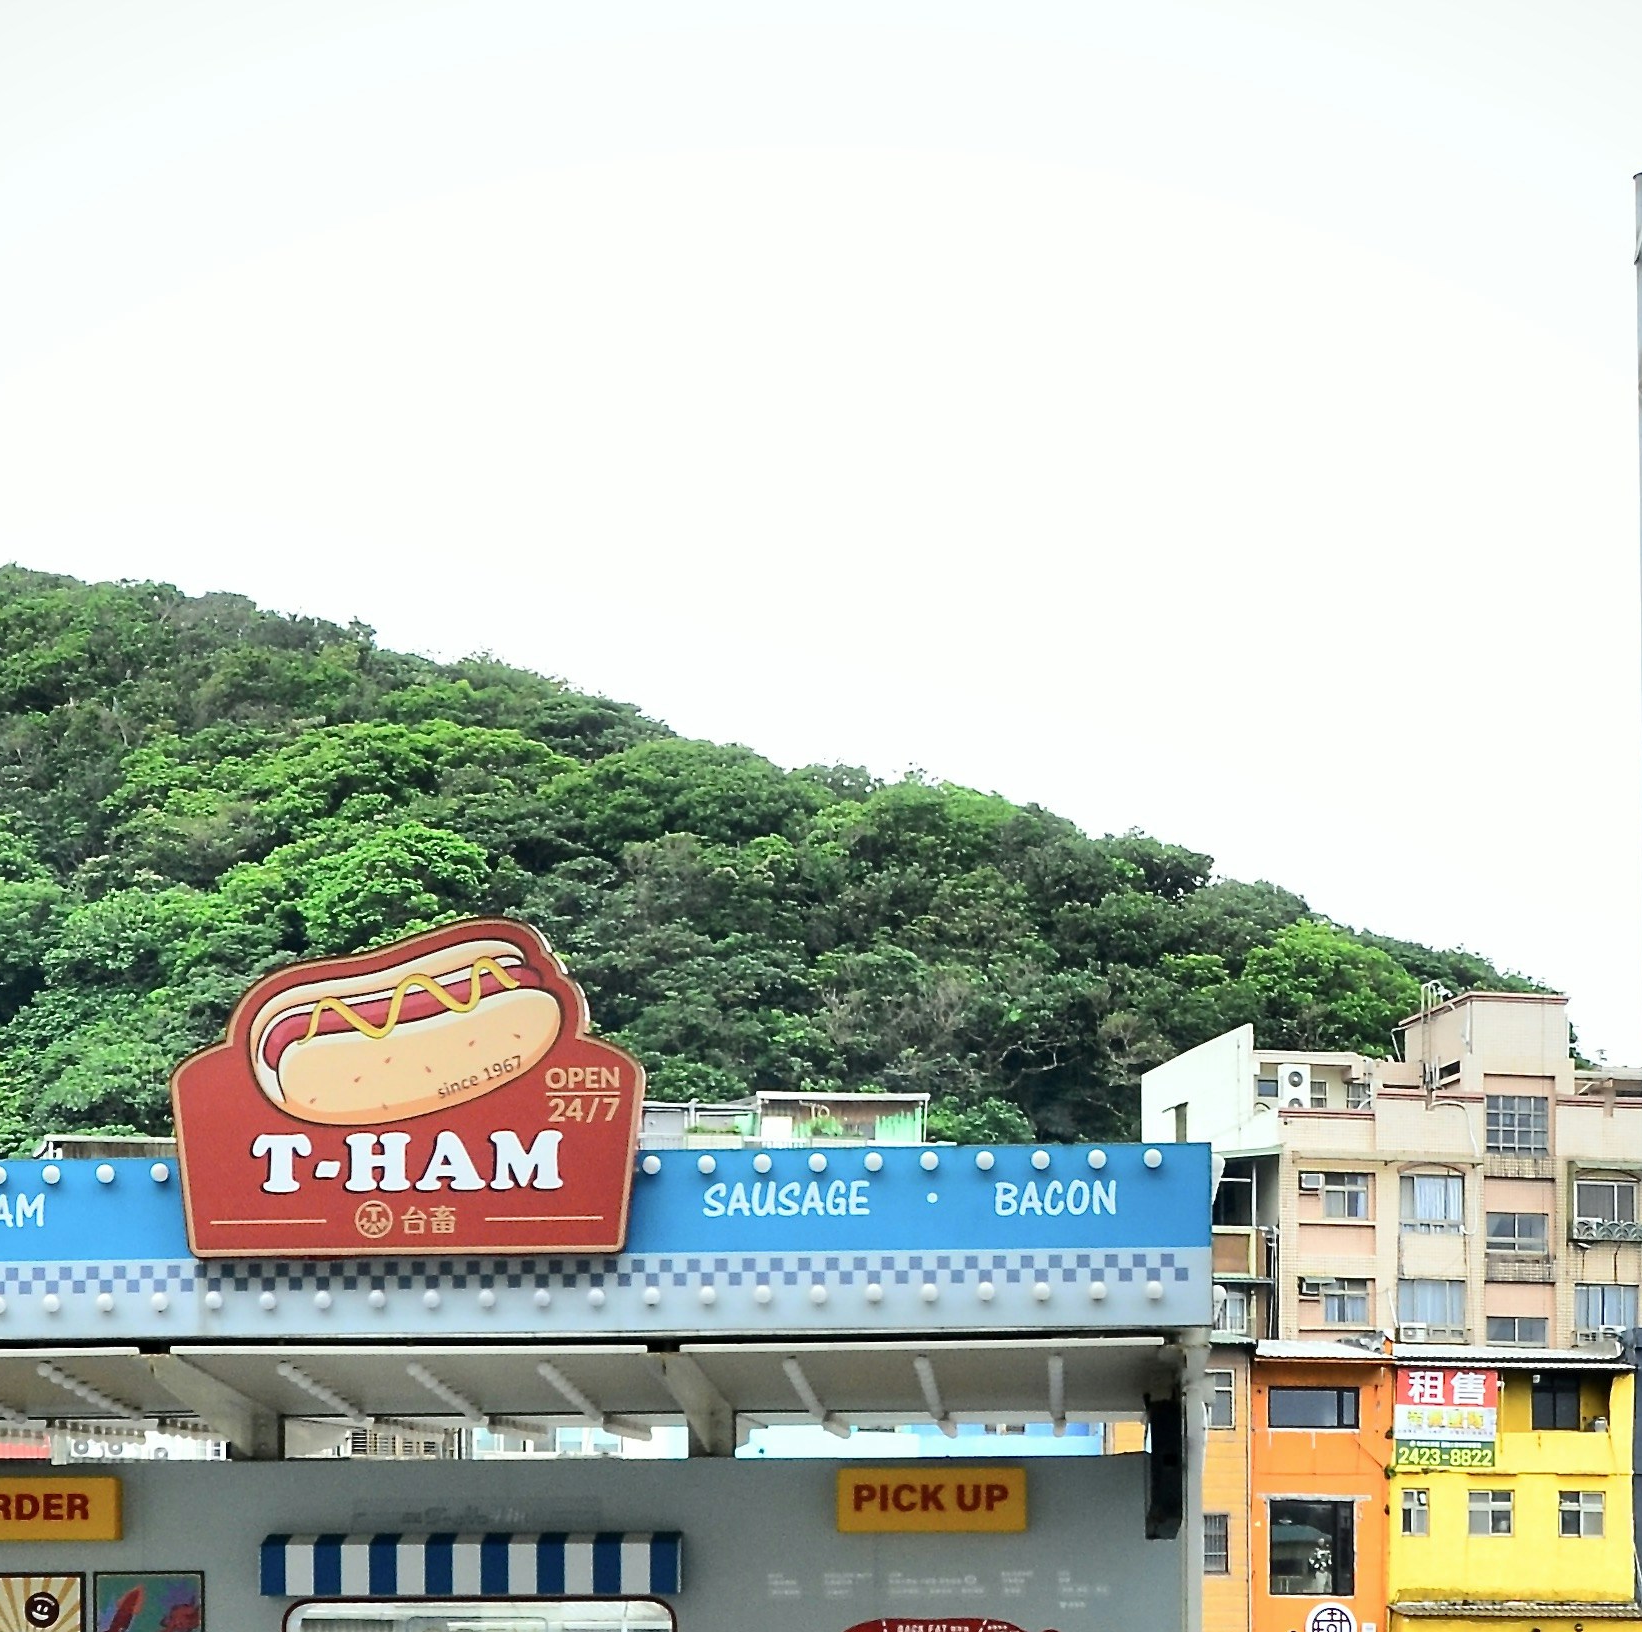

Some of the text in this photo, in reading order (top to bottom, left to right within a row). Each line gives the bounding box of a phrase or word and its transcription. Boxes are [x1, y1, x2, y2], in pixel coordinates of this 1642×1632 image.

[437, 1055, 523, 1100] since 1967
[545, 1066, 621, 1090] OPEN
[546, 1098, 621, 1123] 24/7
[251, 1130, 564, 1193] T-HAM
[701, 1178, 1117, 1218] SAUSAGE BACON
[401, 1205, 456, 1234] 台畜
[1408, 1371, 1487, 1406] 租售
[1398, 1446, 1493, 1467] 2423-8822
[852, 1484, 1010, 1512] PICK UP
